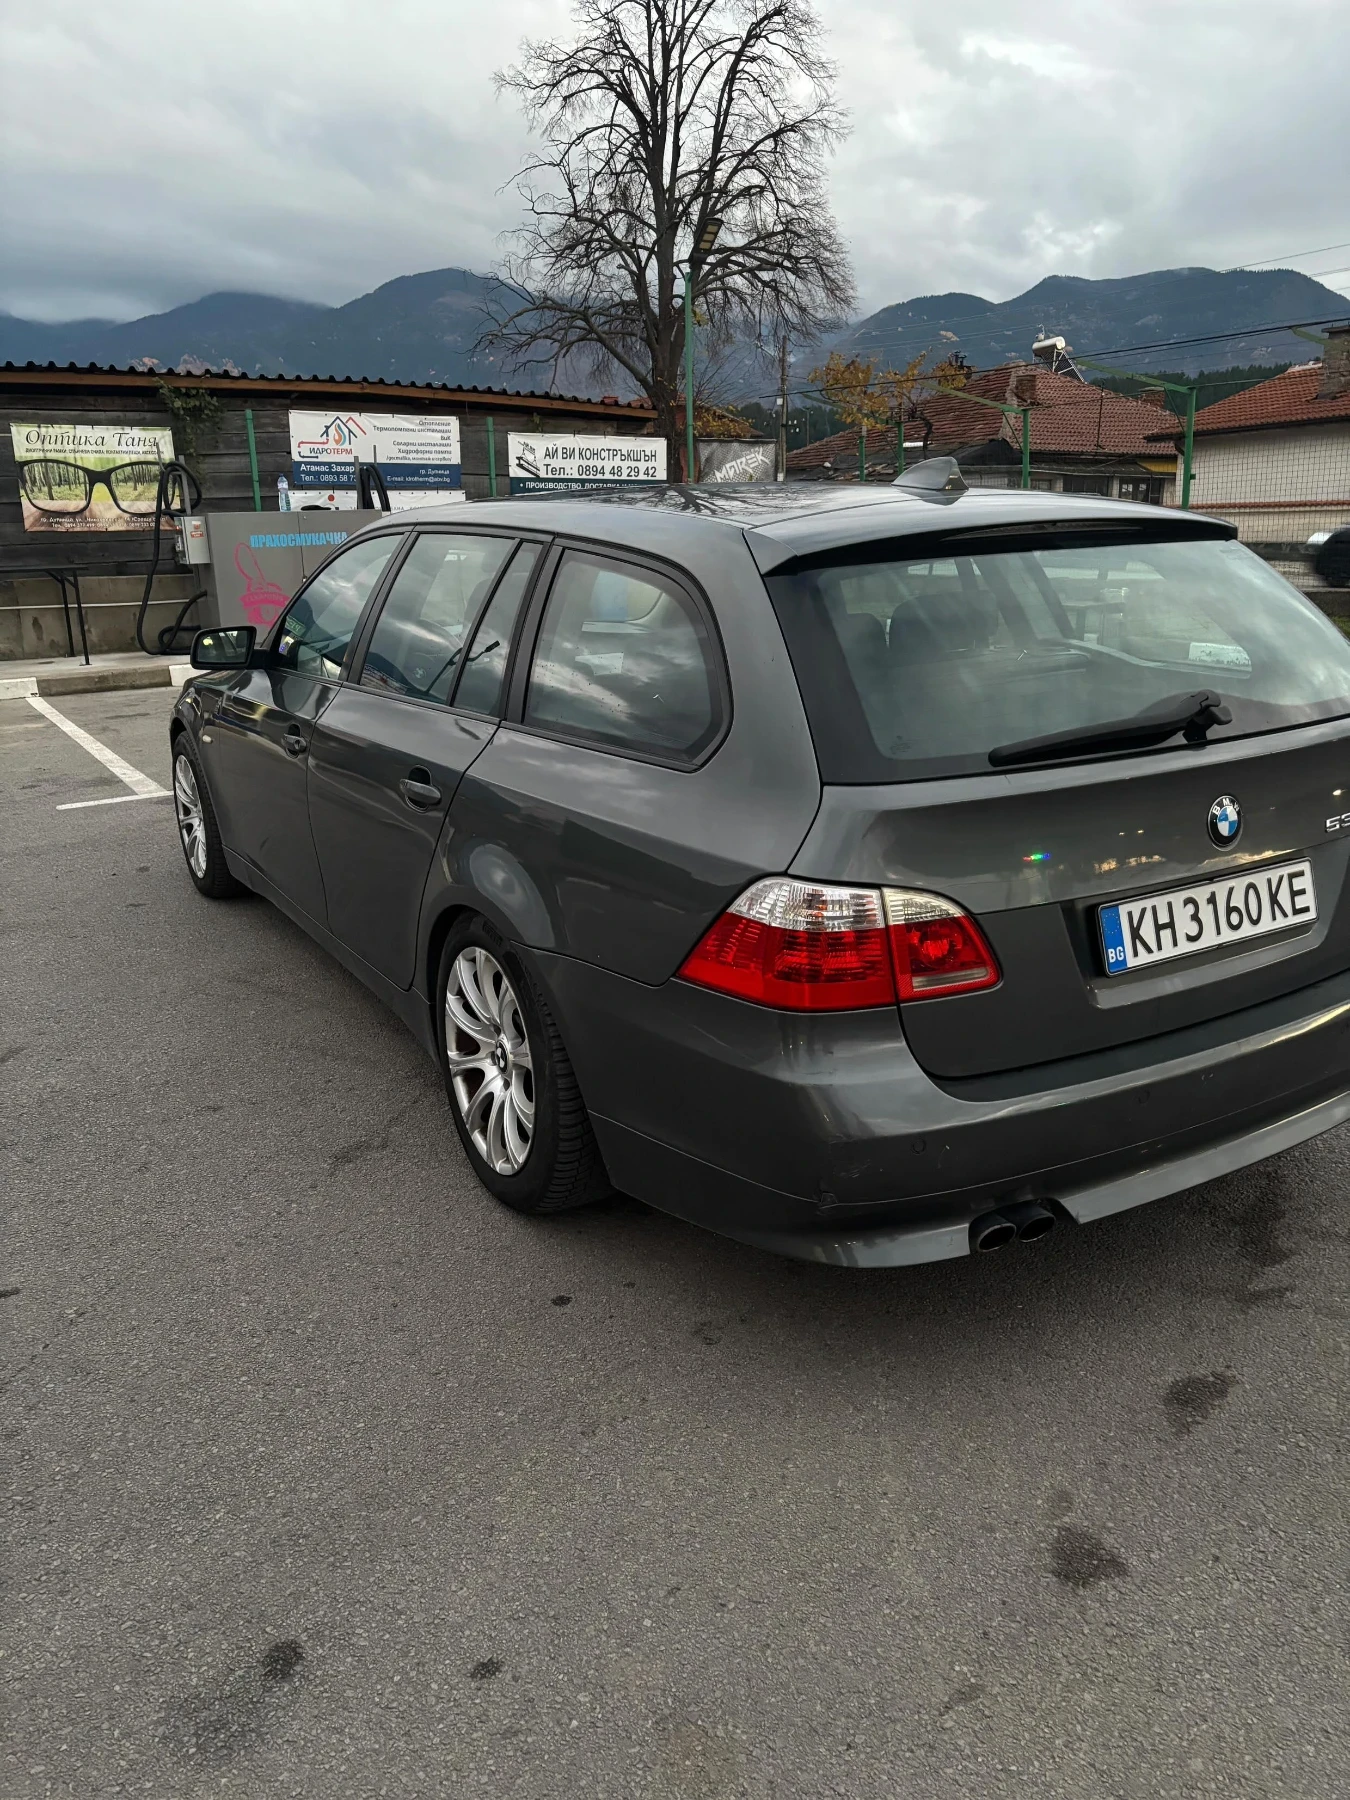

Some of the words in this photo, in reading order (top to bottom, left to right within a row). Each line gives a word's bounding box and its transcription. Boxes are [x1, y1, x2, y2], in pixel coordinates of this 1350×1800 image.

[25, 429, 107, 447] Оптика
[113, 432, 158, 447] Таня
[309, 447, 353, 455] ИДРОТЕРМ
[543, 443, 559, 460] АЙ
[561, 447, 576, 460] ВИ
[578, 447, 657, 462] КОНСТРЪКШЪН
[300, 463, 330, 472] Атанас
[331, 463, 355, 473] Захар
[543, 464, 573, 477] Тел.:
[577, 464, 605, 477] 0894
[609, 465, 623, 477] 48
[626, 465, 640, 477] 29
[643, 466, 657, 477] 42
[300, 474, 318, 482] Тел.:
[320, 474, 338, 482] 0893
[339, 474, 348, 482] 58
[250, 531, 348, 548] ПРАХОСМУКАЧКА
[1107, 945, 1126, 963] BG
